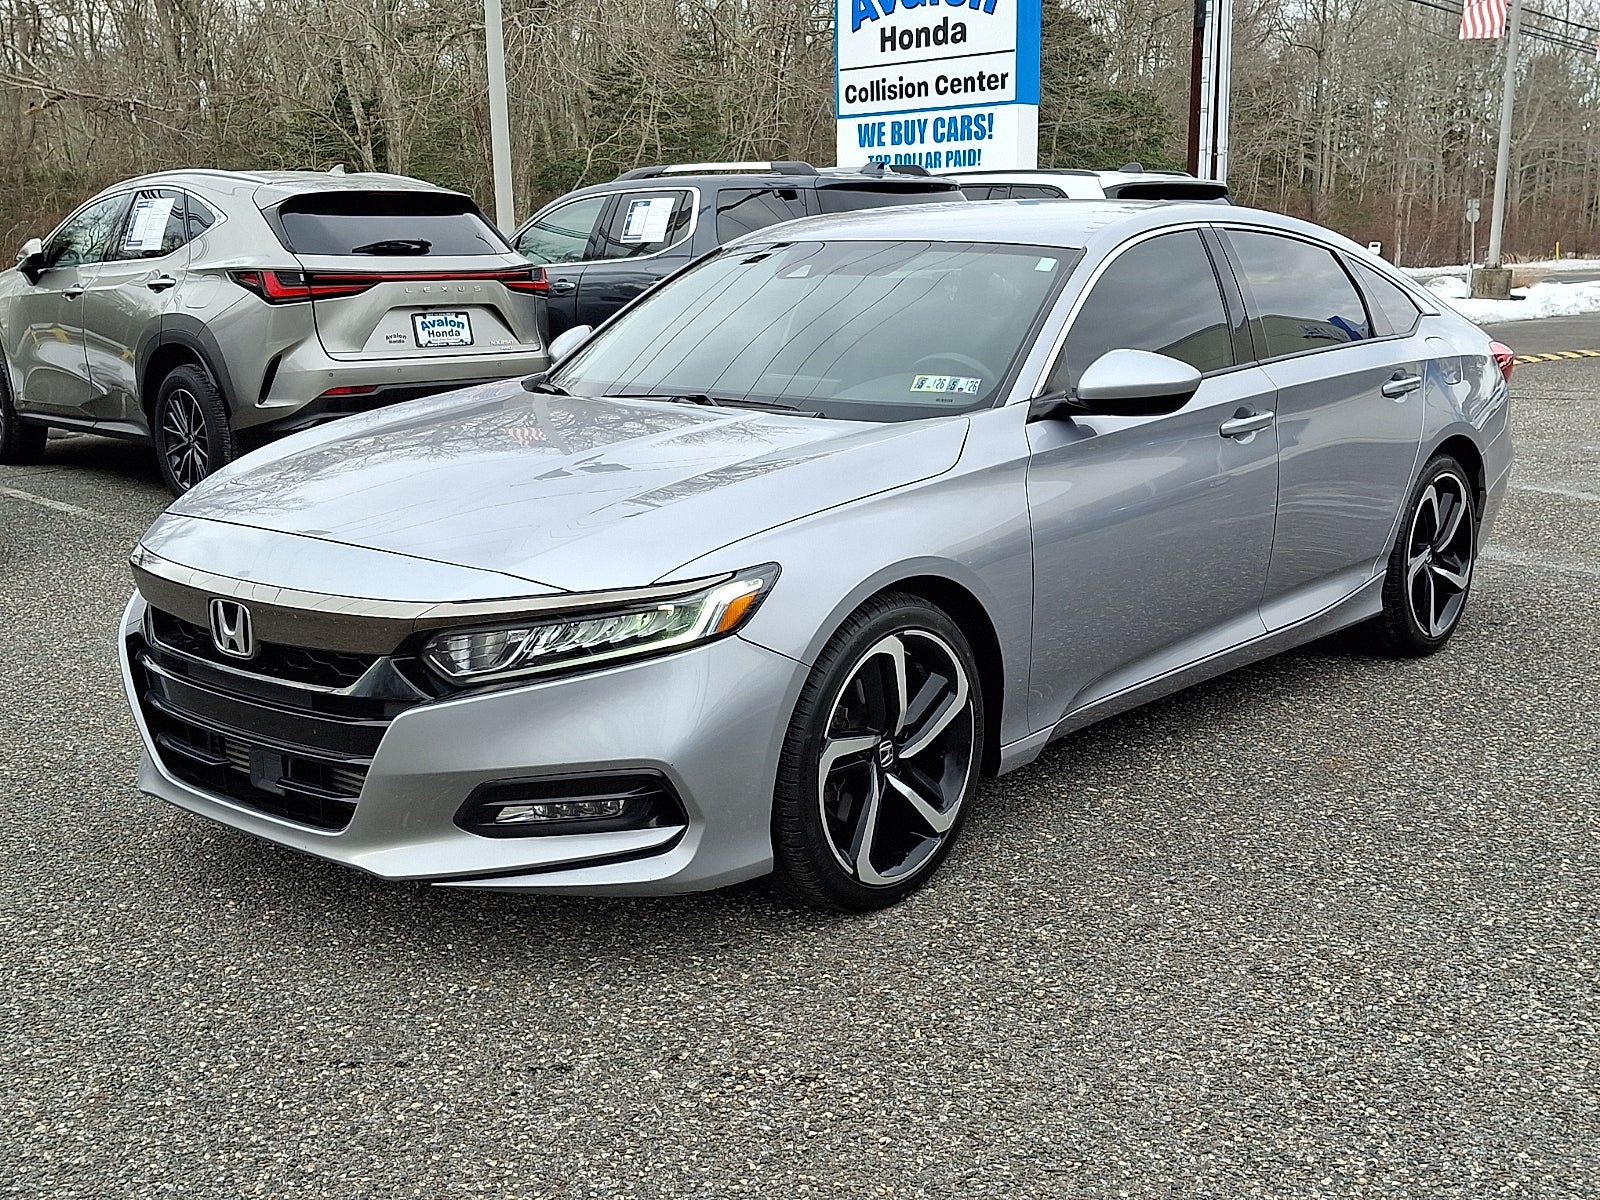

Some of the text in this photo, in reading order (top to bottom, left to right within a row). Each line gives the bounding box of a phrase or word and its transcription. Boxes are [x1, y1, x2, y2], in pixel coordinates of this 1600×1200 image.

[852, 0, 998, 33] Avn
[880, 16, 967, 53] Honda
[845, 71, 1009, 104] Collision Center
[857, 113, 994, 148] WE BUY CARS!
[945, 148, 982, 168] PAID!
[405, 285, 481, 293] LEXUS
[420, 316, 465, 331] Avalon
[427, 328, 461, 338] Honda
